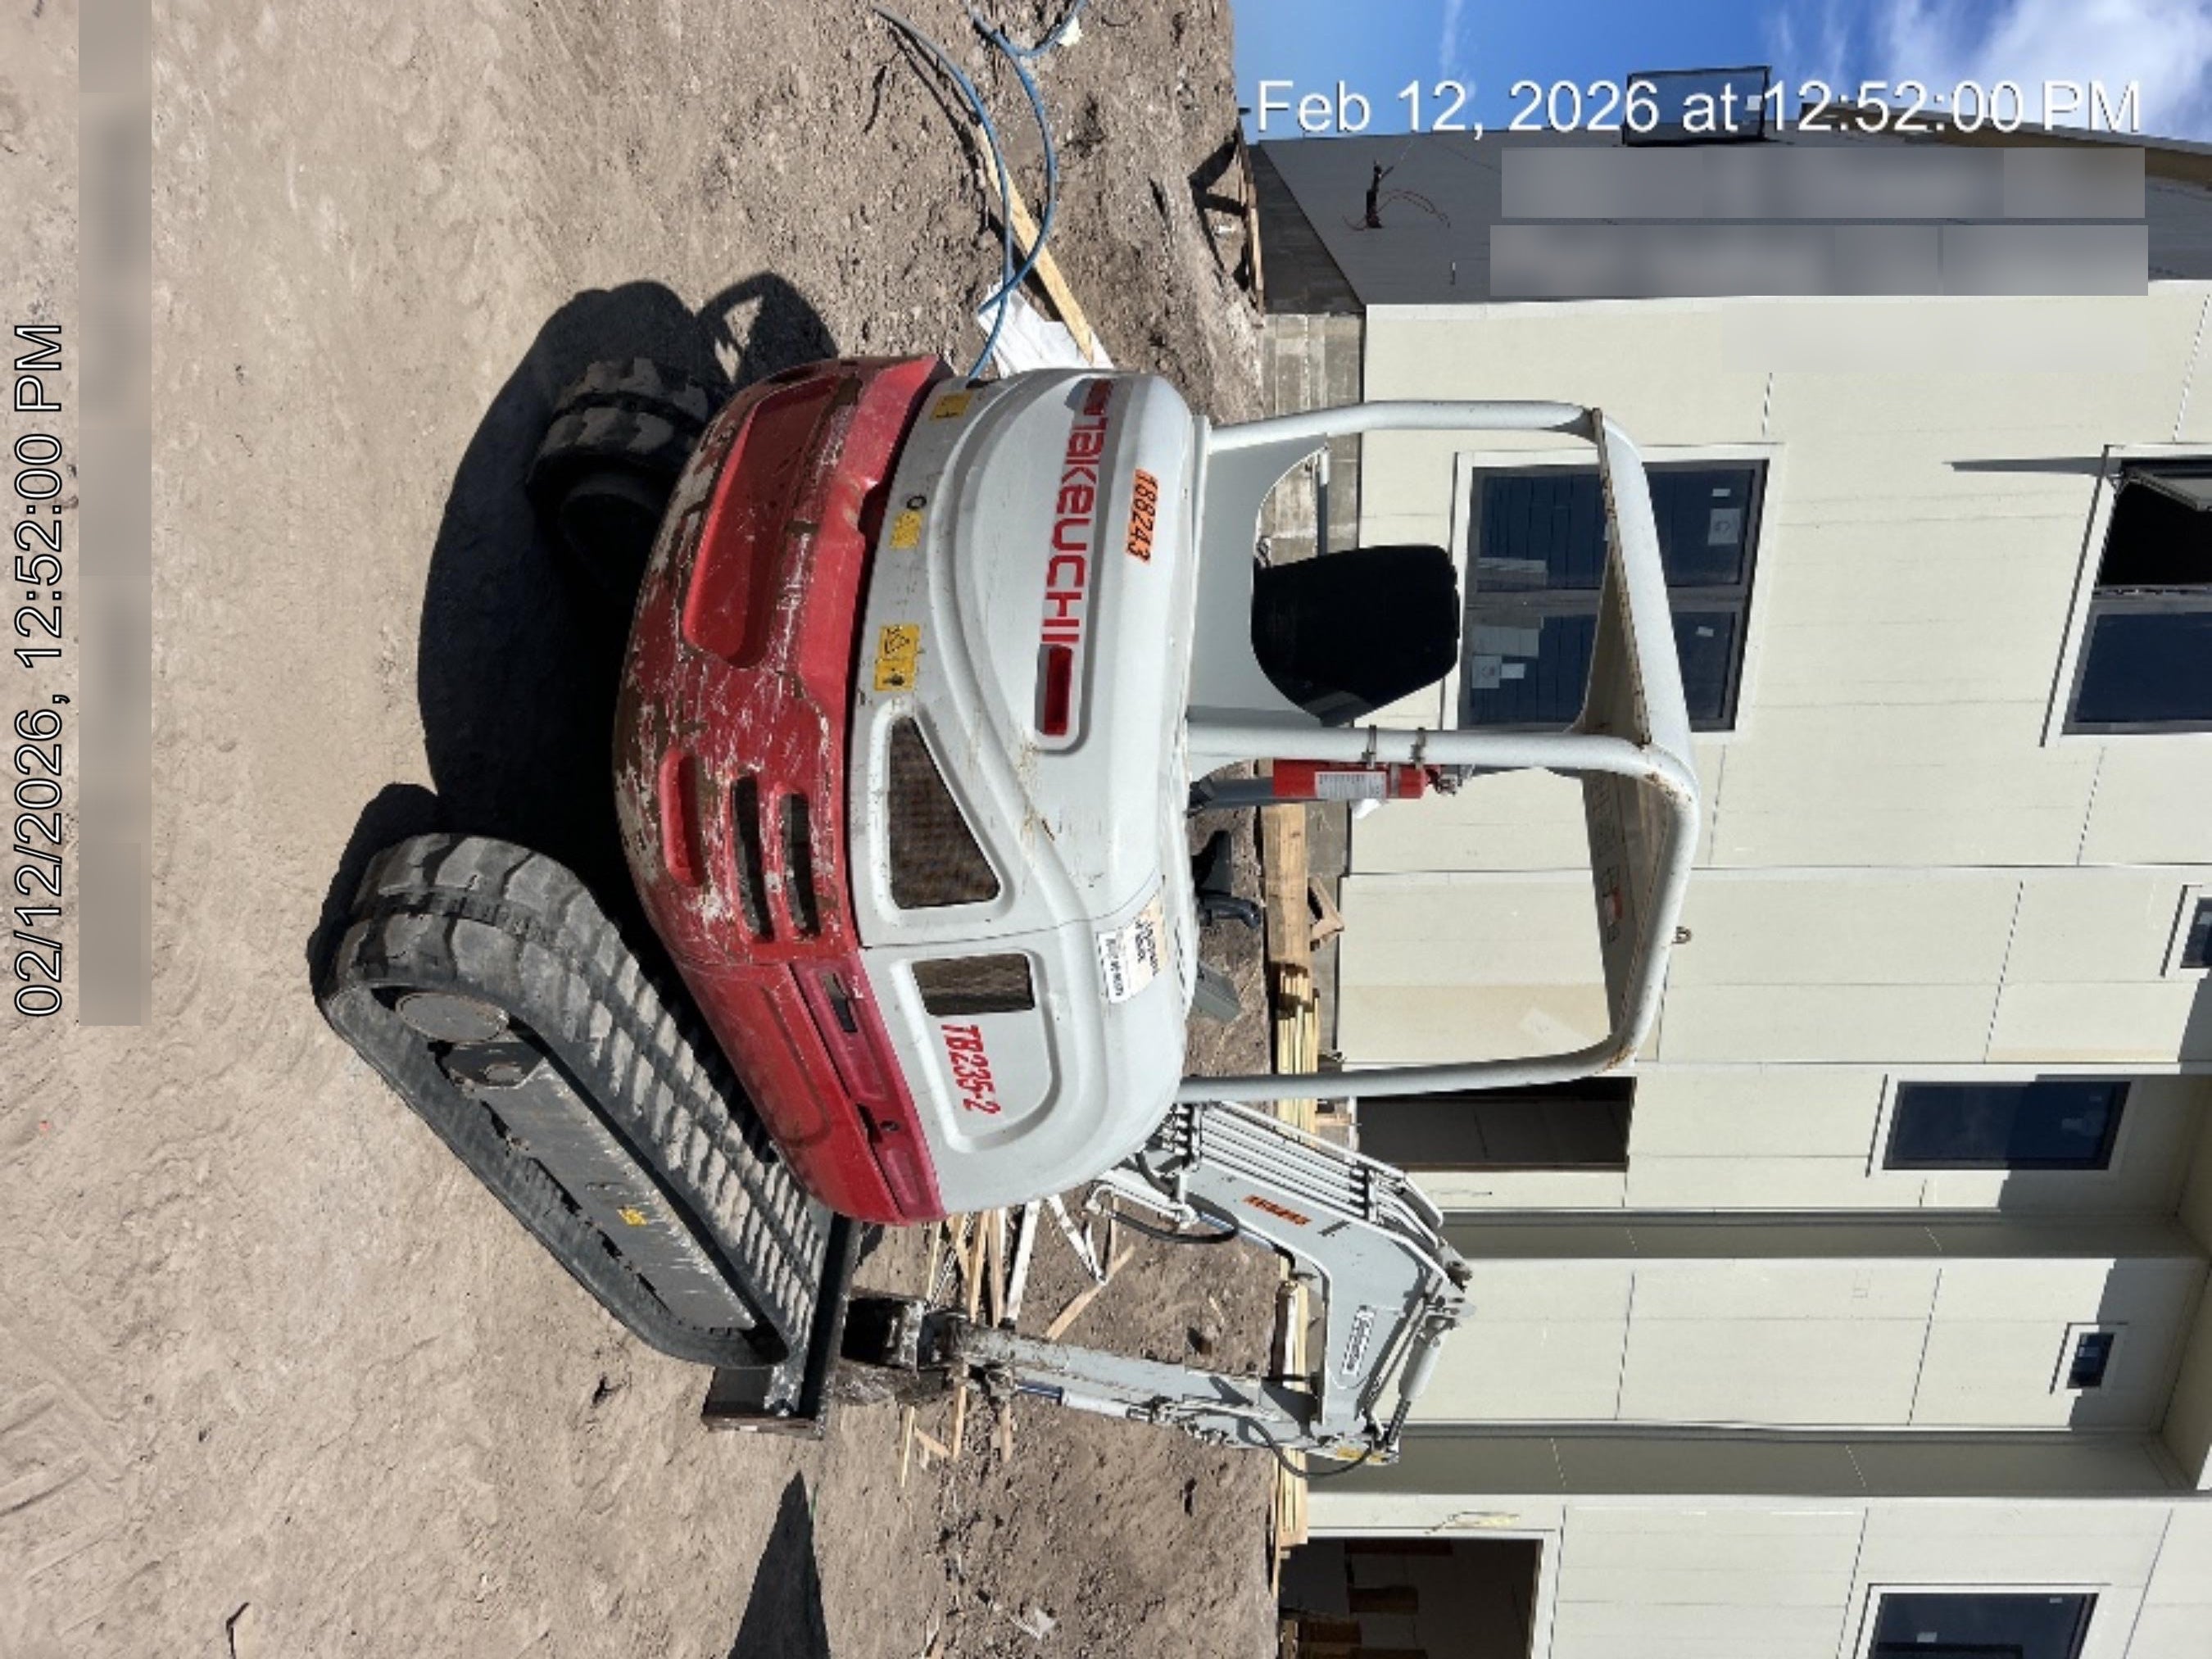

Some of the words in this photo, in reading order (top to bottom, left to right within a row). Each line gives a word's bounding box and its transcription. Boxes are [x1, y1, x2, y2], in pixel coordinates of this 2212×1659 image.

[1041, 417, 1108, 643] TAKEUCHI
[1127, 472, 1158, 563] 188243
[941, 1024, 1001, 1115] TB235-2
